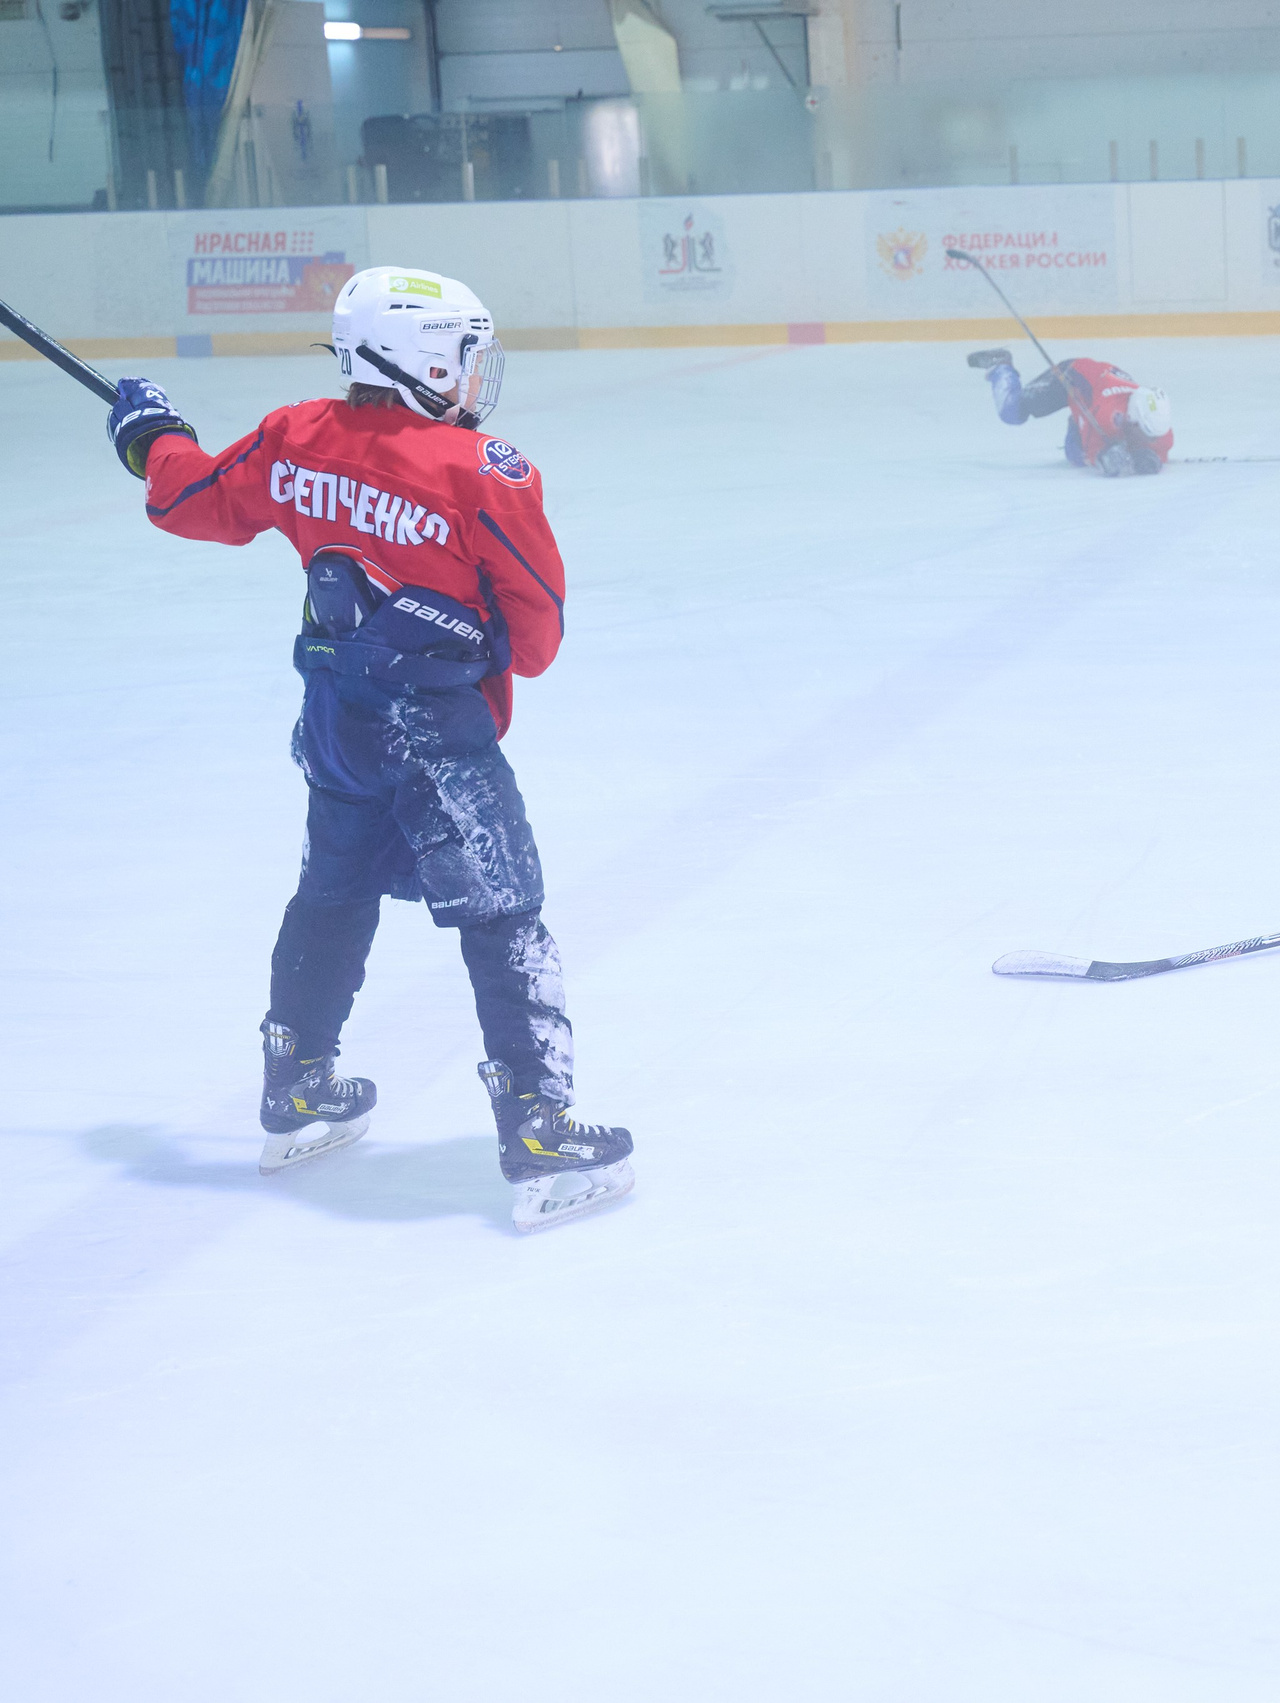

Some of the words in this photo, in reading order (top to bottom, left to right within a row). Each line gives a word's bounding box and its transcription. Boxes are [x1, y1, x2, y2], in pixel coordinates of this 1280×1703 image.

[194, 232, 287, 253] КРАСНАЯ
[1025, 252, 1107, 268] РОССИИ
[193, 260, 290, 284] МАШИНА
[410, 280, 438, 294] Airlines
[422, 321, 462, 331] BAUER
[338, 348, 352, 376] 20
[415, 385, 448, 406] BAUER
[487, 442, 512, 459] 10
[393, 596, 485, 645] BAUER
[431, 896, 469, 909] BAUER
